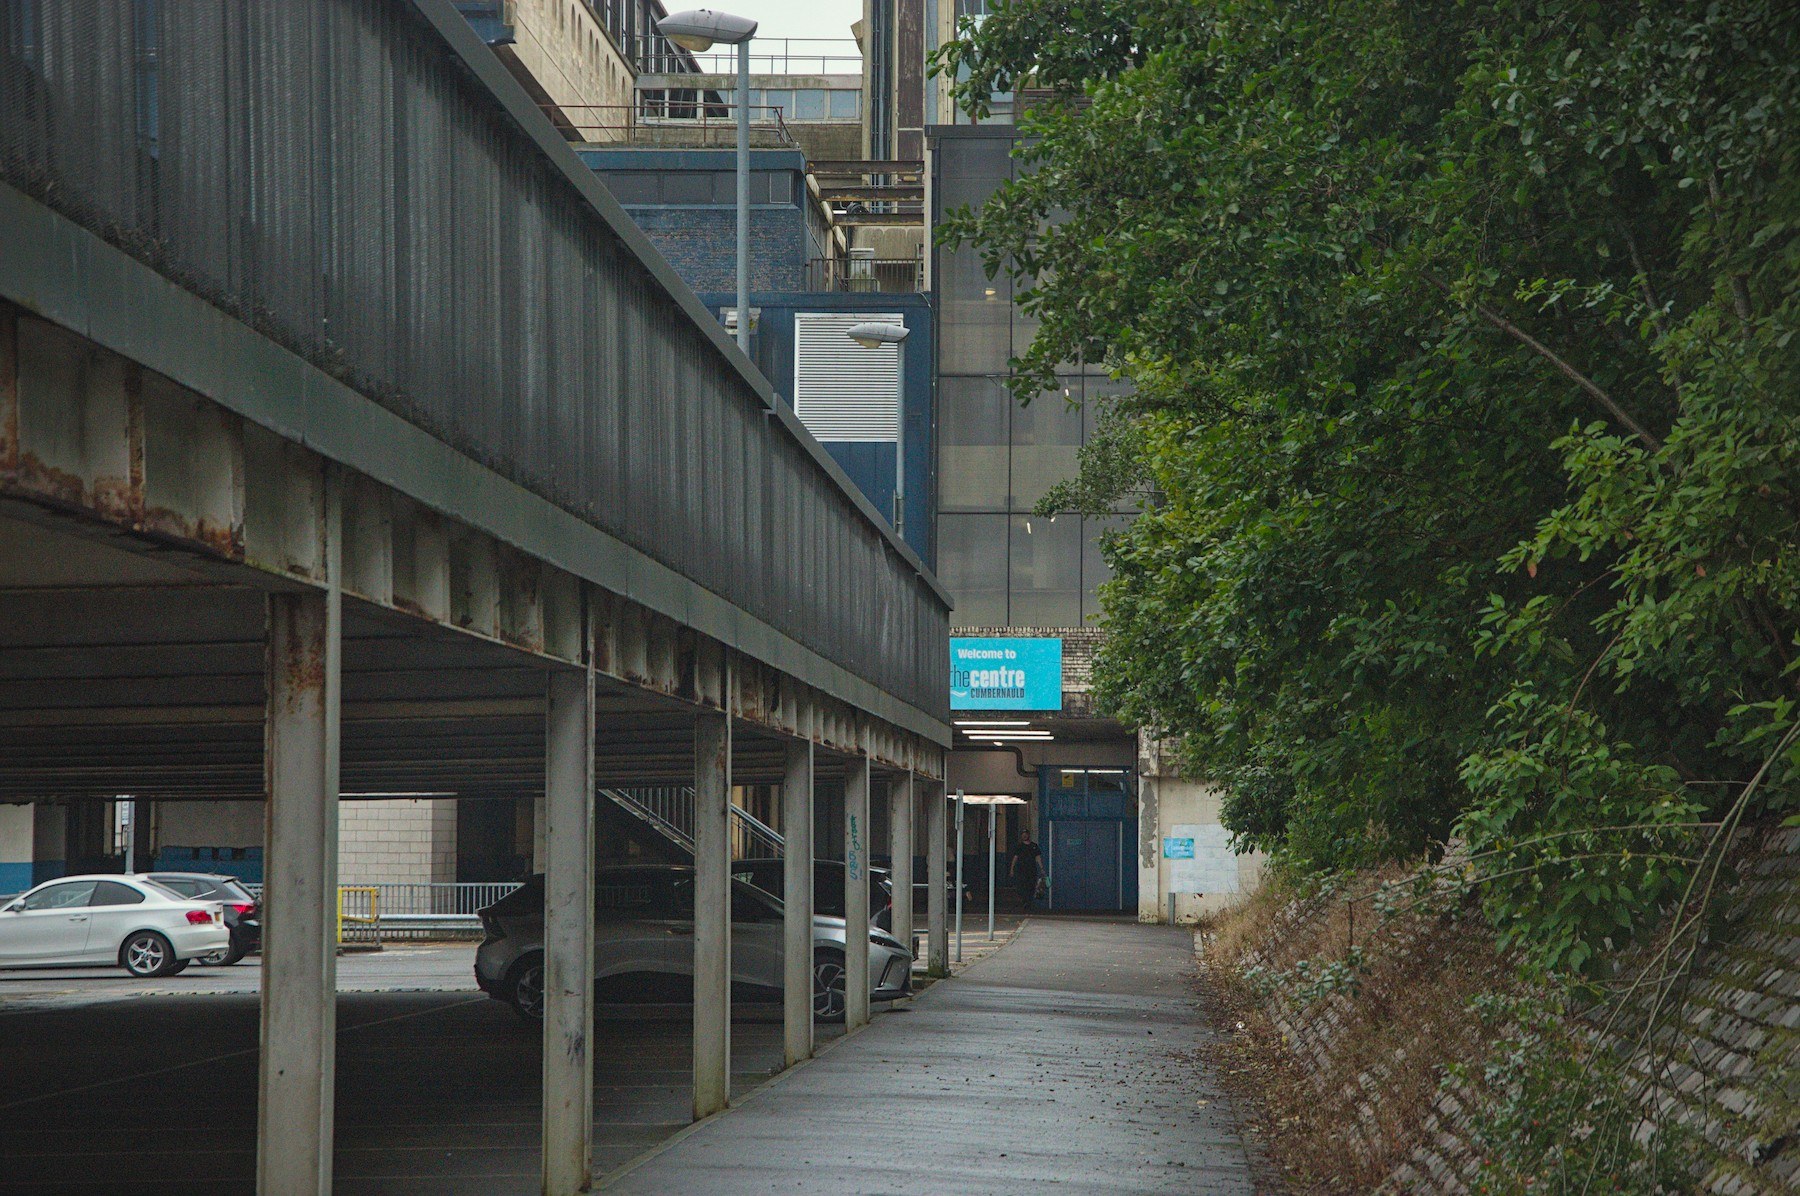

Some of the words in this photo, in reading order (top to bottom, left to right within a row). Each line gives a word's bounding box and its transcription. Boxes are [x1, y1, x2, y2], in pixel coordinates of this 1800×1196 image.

[957, 648, 1003, 659] Welcome
[1004, 648, 1017, 659] to
[970, 665, 1025, 688] centre
[970, 688, 1025, 699] CUMBERNAULD
